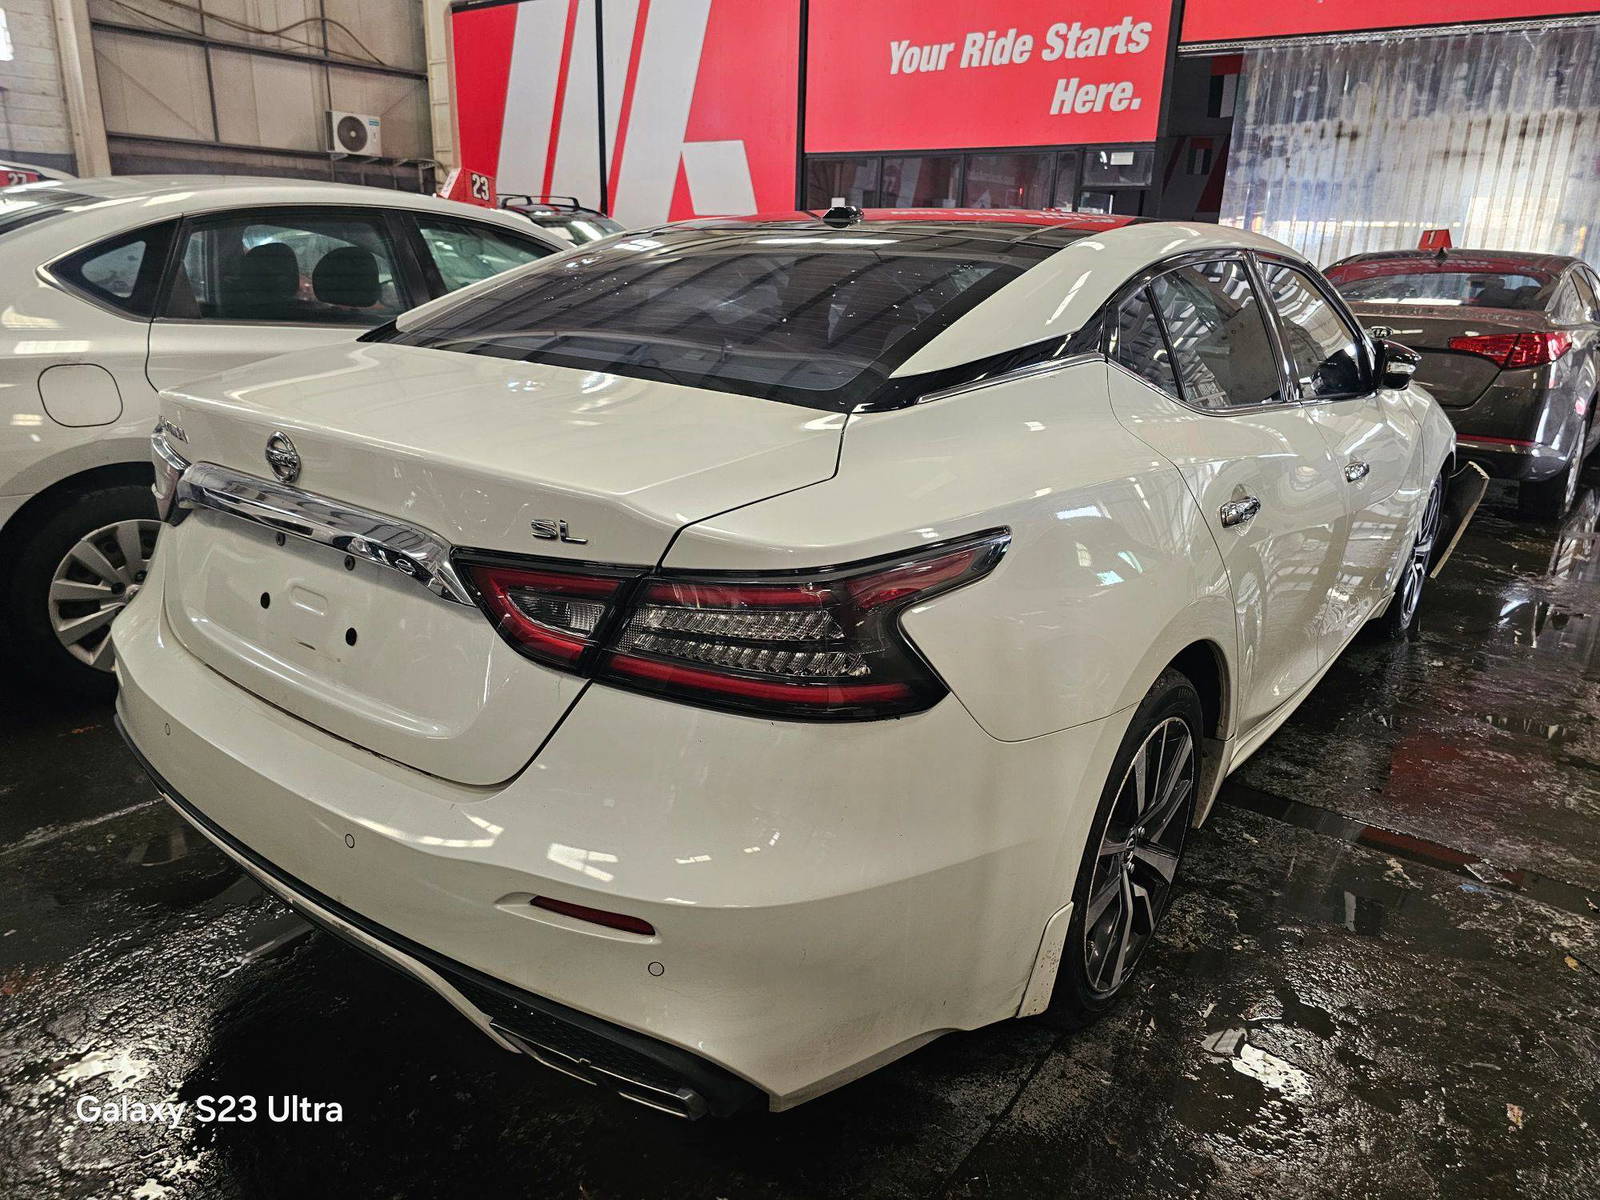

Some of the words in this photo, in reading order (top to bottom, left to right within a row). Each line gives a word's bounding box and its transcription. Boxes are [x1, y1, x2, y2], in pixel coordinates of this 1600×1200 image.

[889, 39, 955, 75] Your
[960, 28, 1034, 69] Ride
[1041, 16, 1153, 62] Starts
[1049, 77, 1142, 116] Here.
[471, 173, 490, 201] 23
[531, 519, 589, 545] SL
